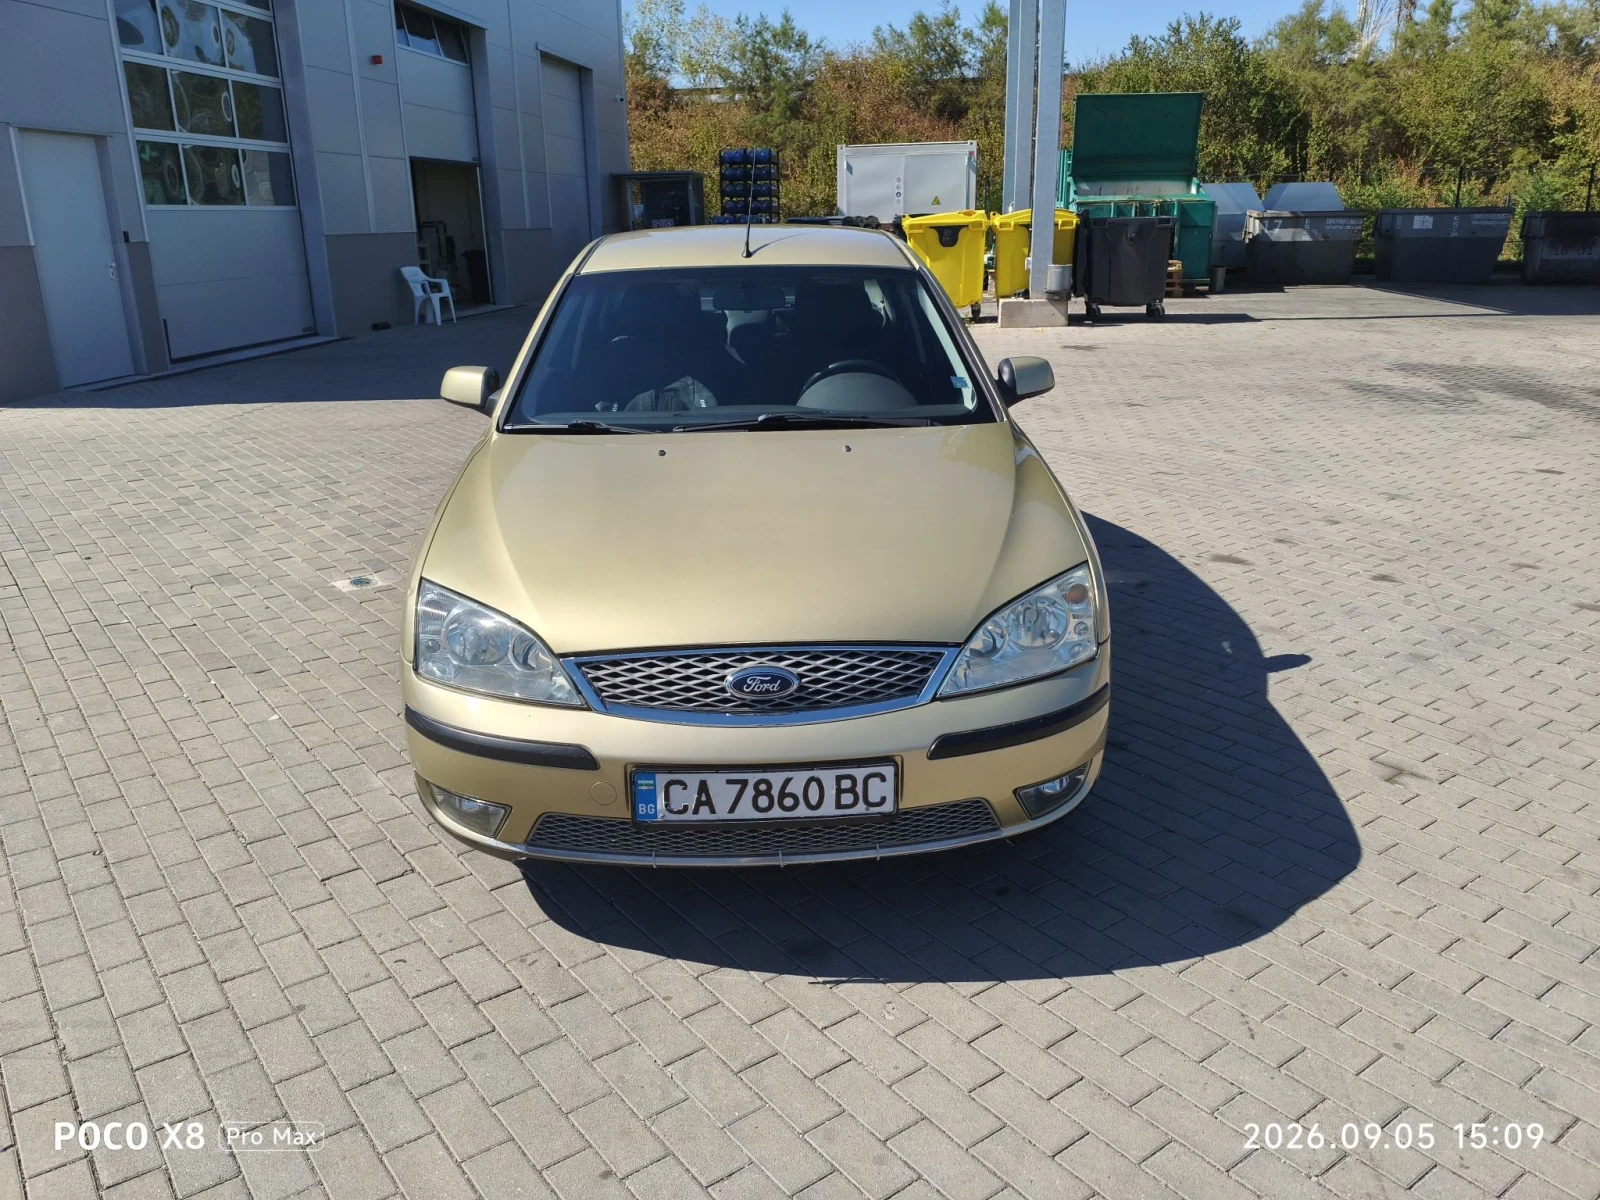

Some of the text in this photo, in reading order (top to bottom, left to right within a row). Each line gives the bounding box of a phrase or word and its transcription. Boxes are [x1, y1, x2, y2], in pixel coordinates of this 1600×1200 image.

[743, 676, 781, 692] Ford
[663, 772, 887, 815] CA 7860 BC
[638, 804, 656, 815] BG
